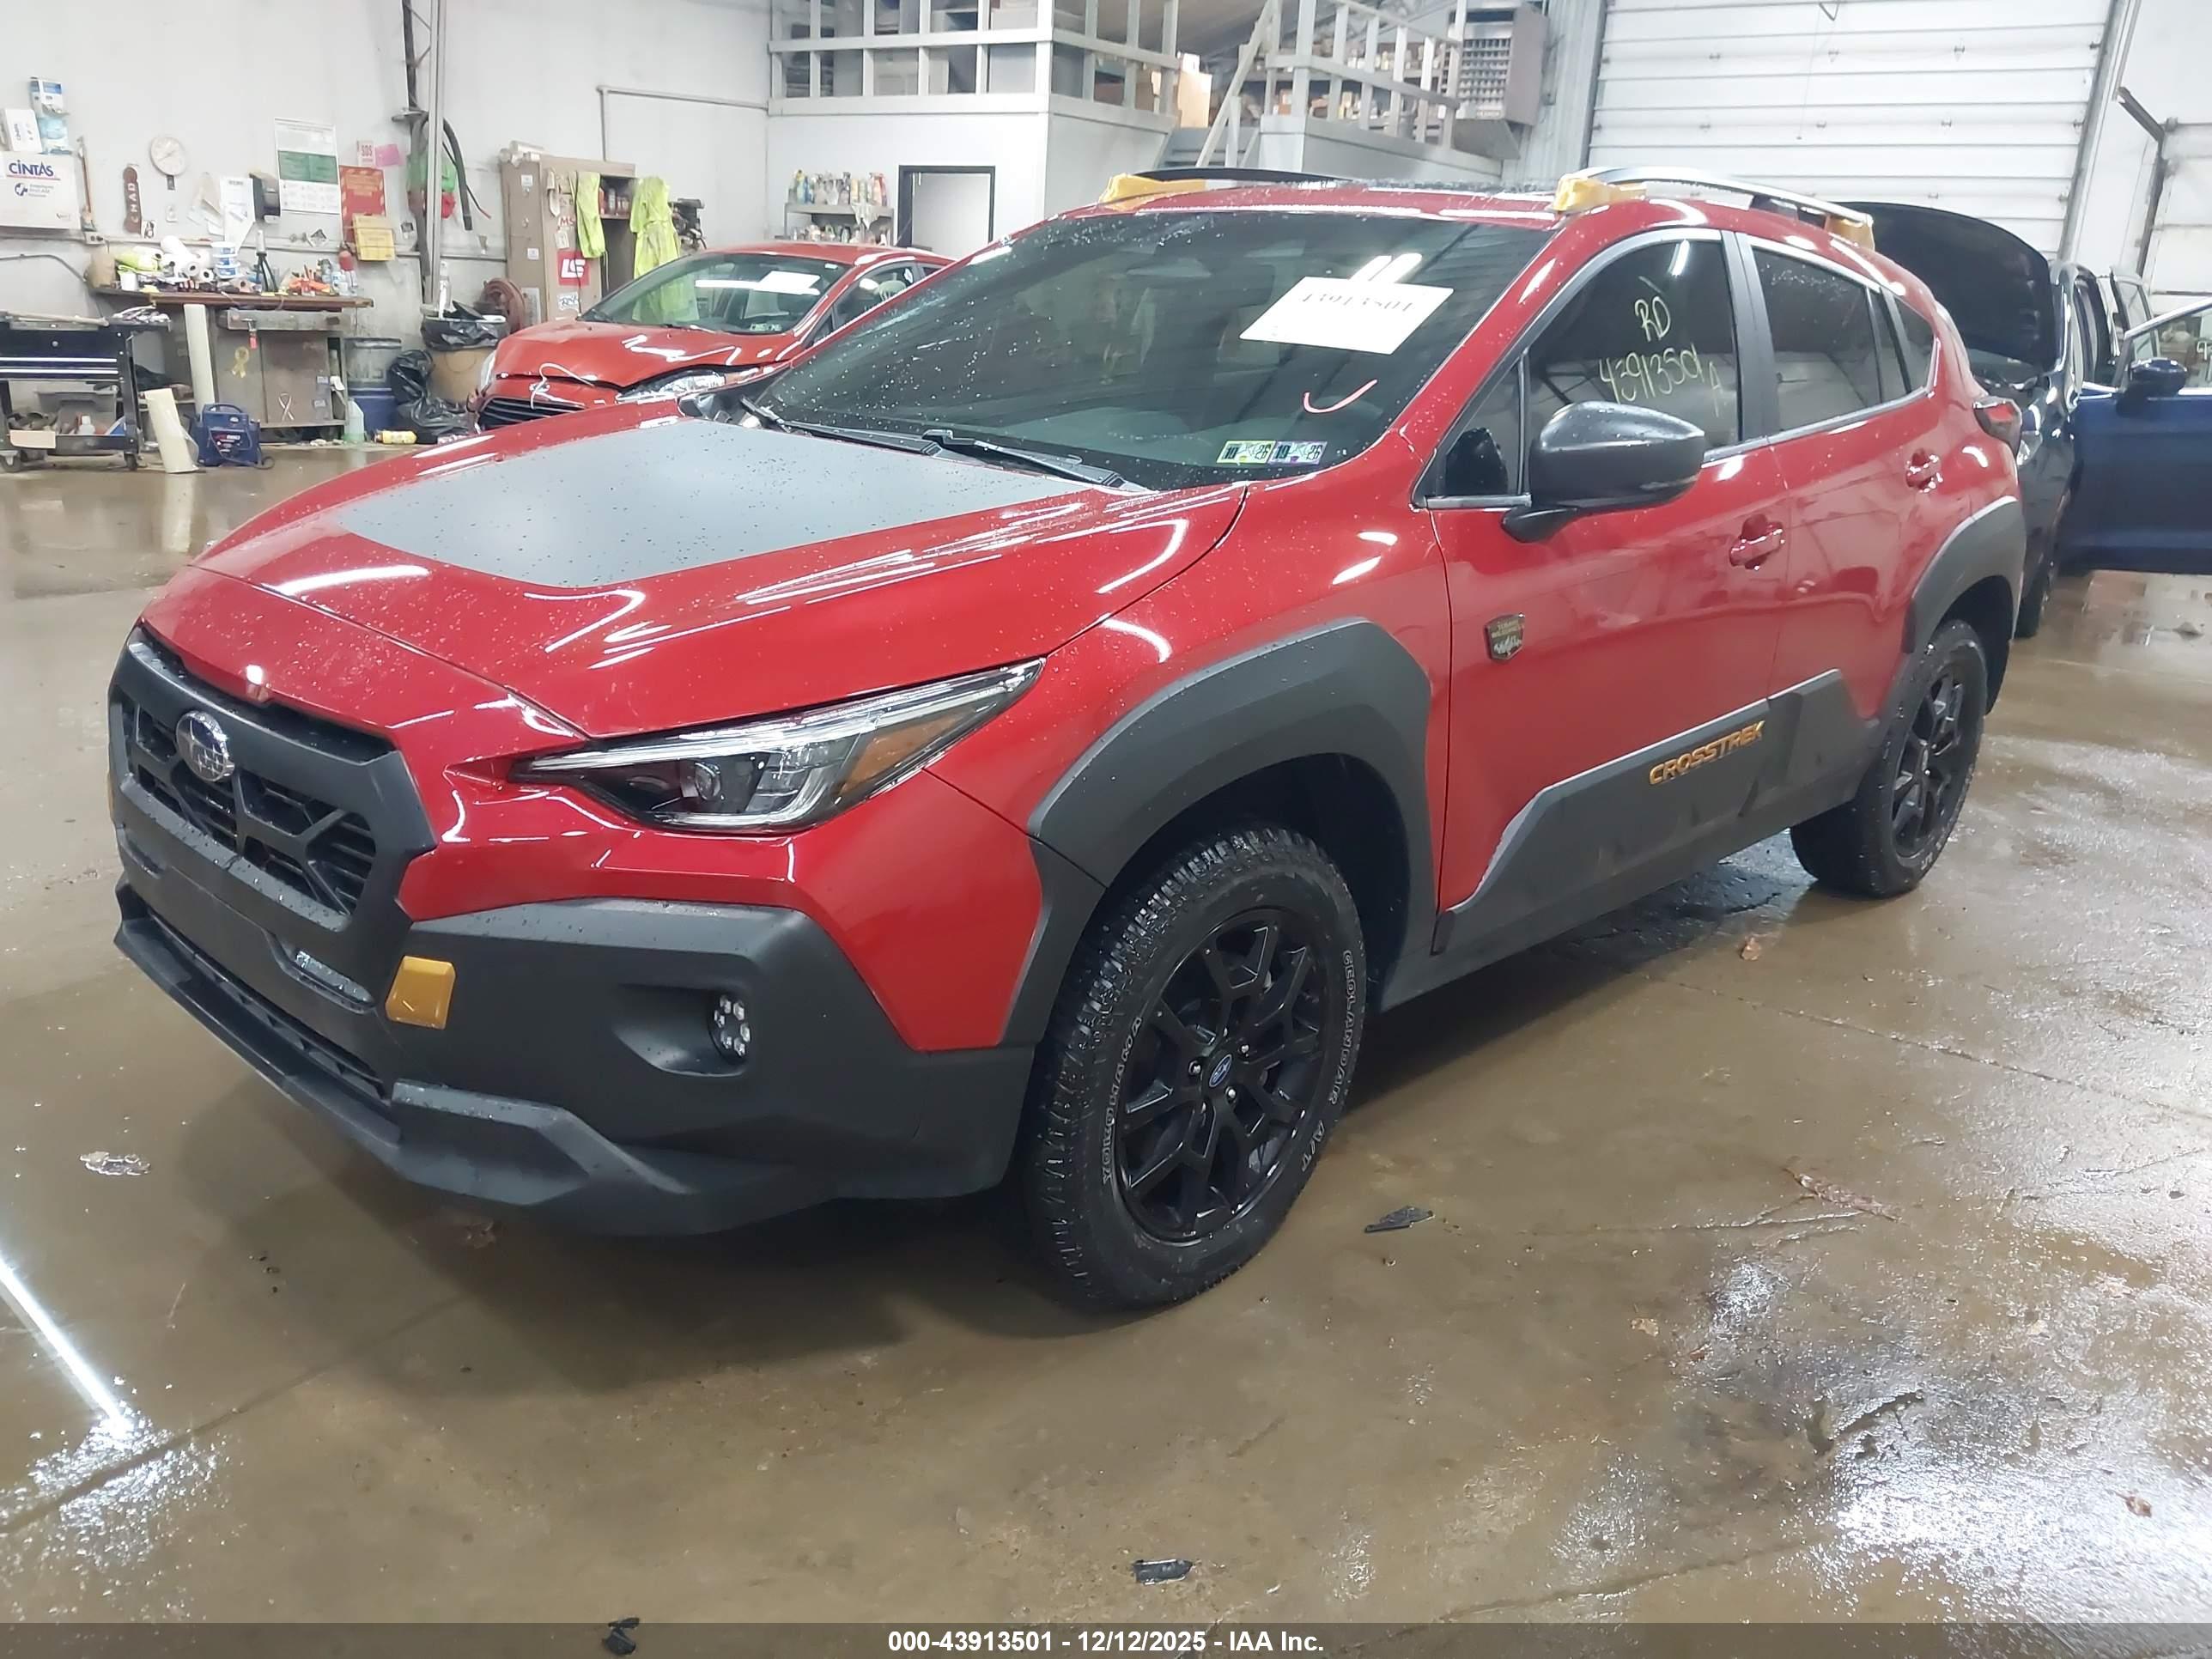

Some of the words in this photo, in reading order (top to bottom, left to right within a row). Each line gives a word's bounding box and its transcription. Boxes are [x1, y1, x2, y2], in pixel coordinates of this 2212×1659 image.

[127, 182, 139, 223] CHAD
[1634, 295, 1671, 342] RD
[1649, 720, 1765, 785] CROSSTREK
[1331, 950, 1357, 1104] GEOLANDAR
[1102, 1017, 1142, 1185] YOKOHAMA
